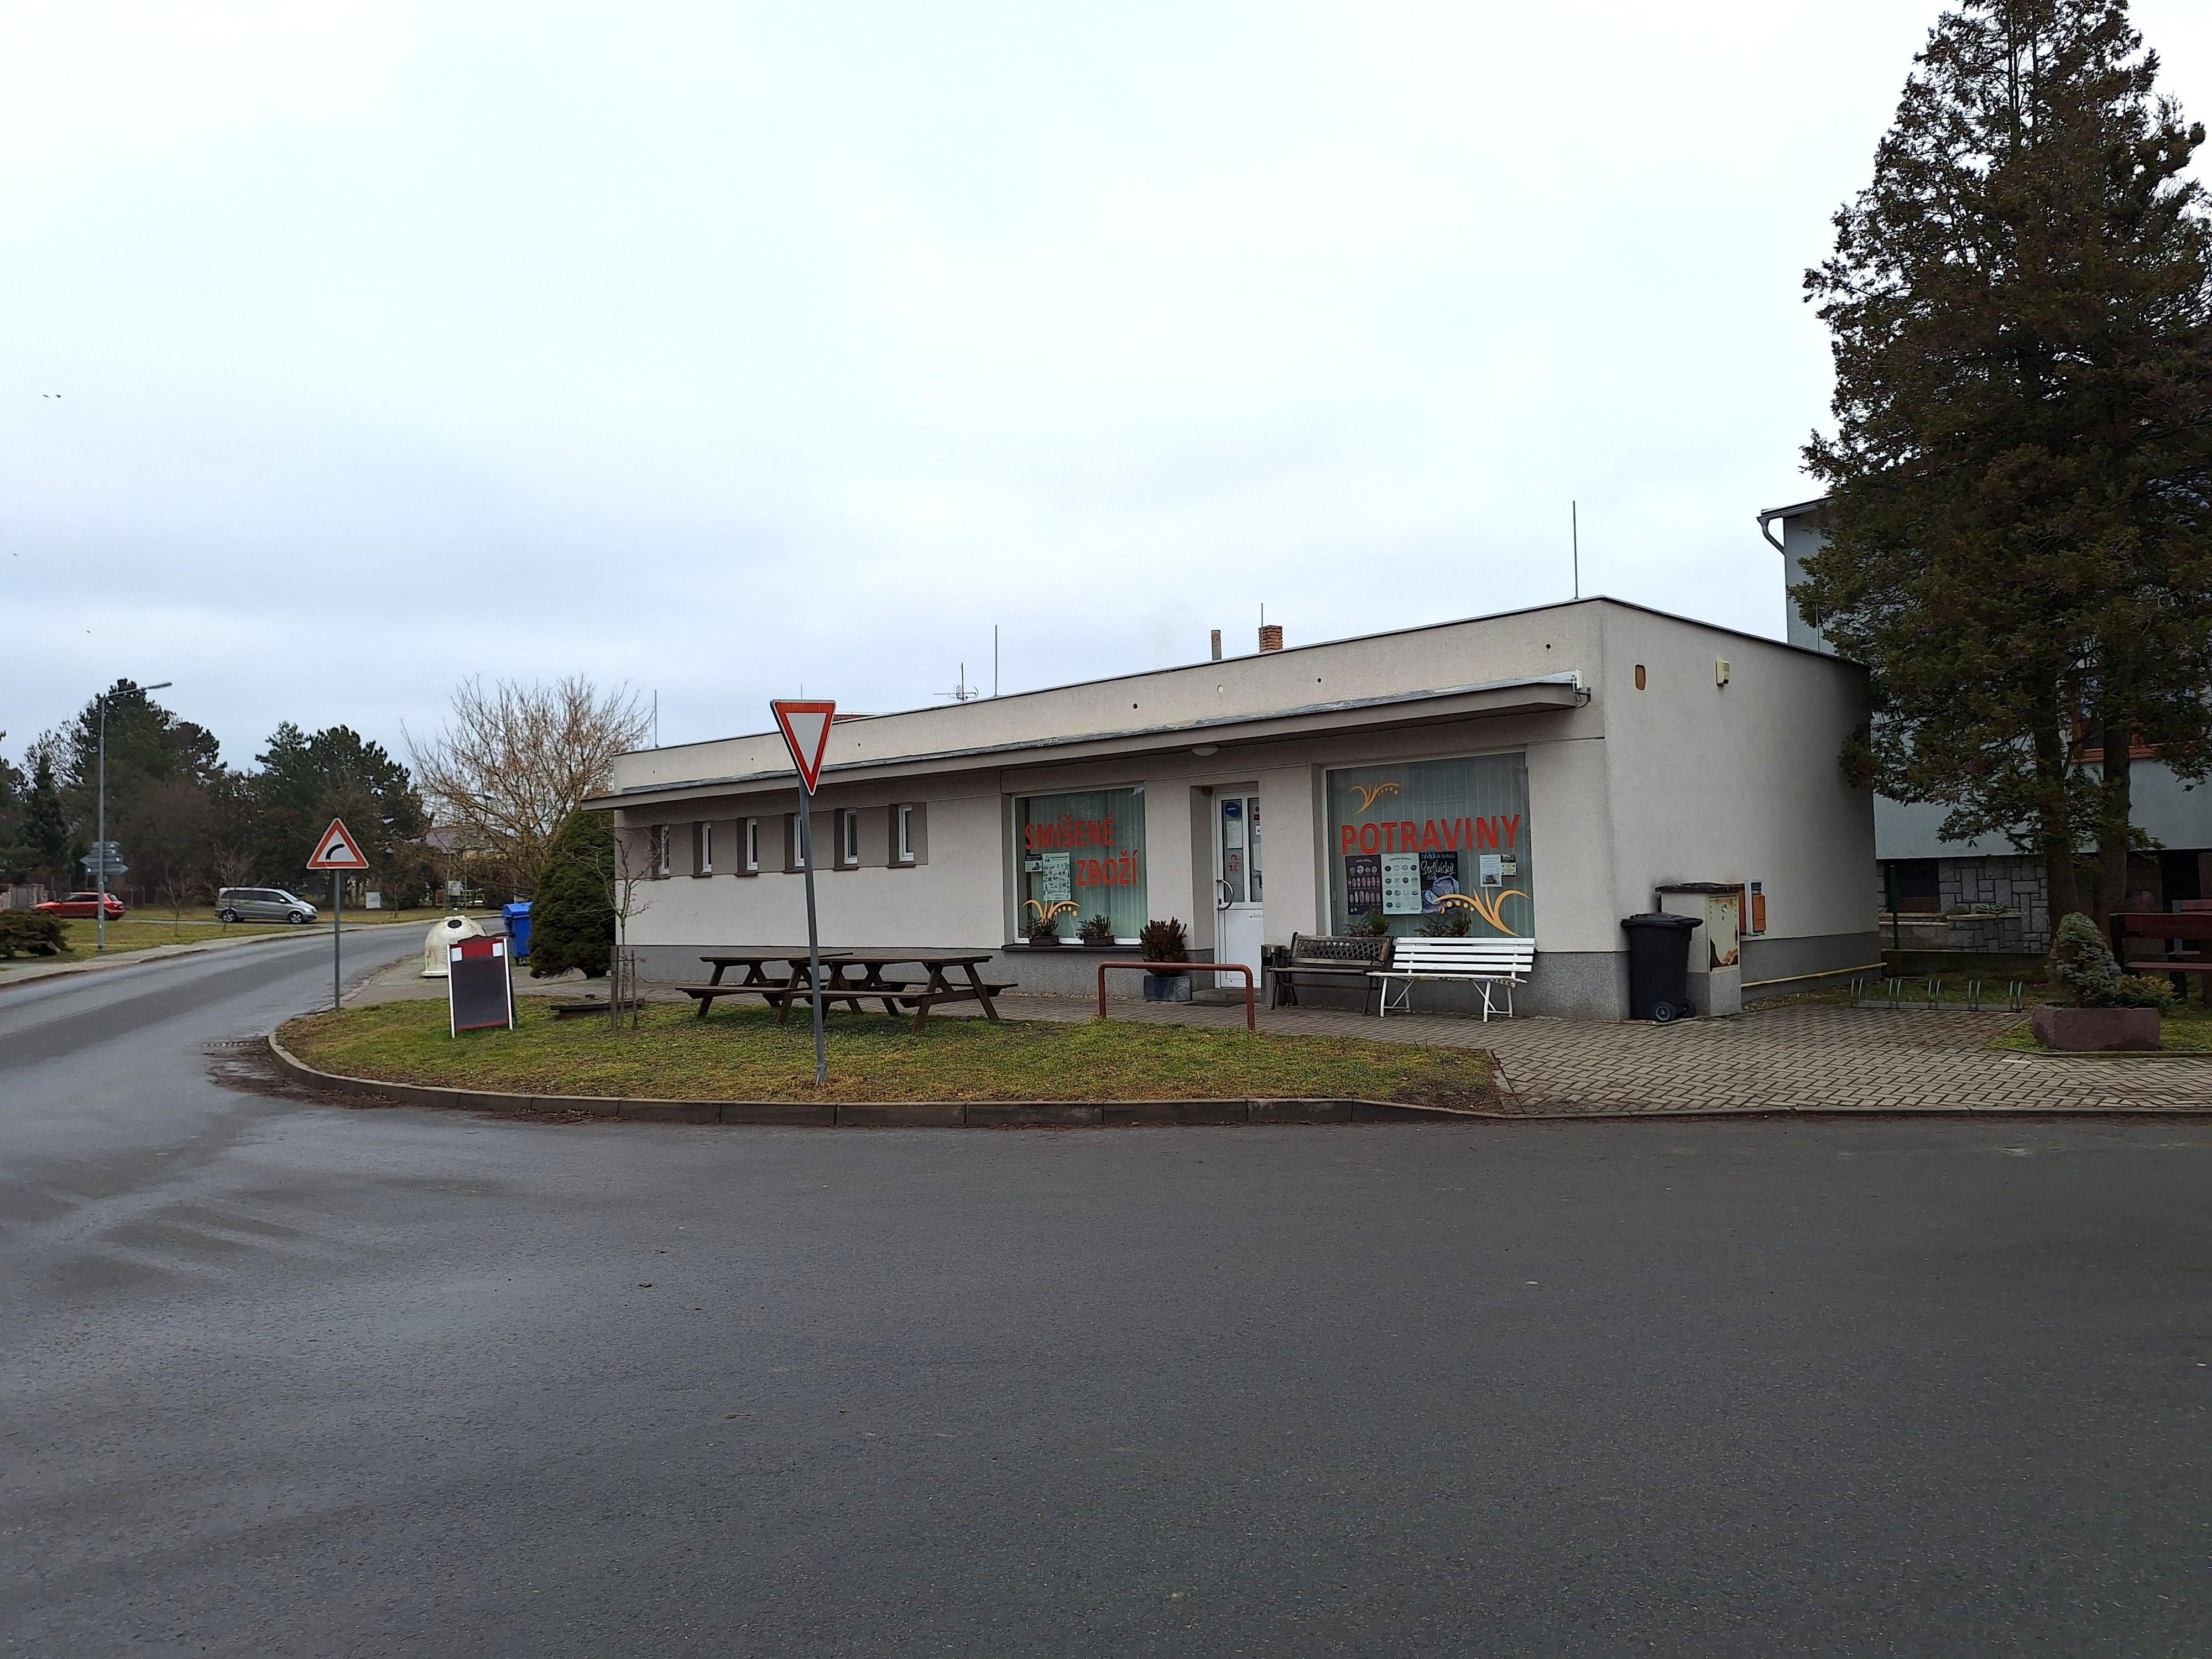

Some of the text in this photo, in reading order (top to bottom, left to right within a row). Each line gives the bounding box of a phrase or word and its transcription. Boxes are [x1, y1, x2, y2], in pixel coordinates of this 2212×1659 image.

[1024, 811, 1115, 850] SMÍŠENÉ
[1341, 815, 1521, 855] POTRAVINY
[1075, 849, 1138, 886] ZBOŽÍ
